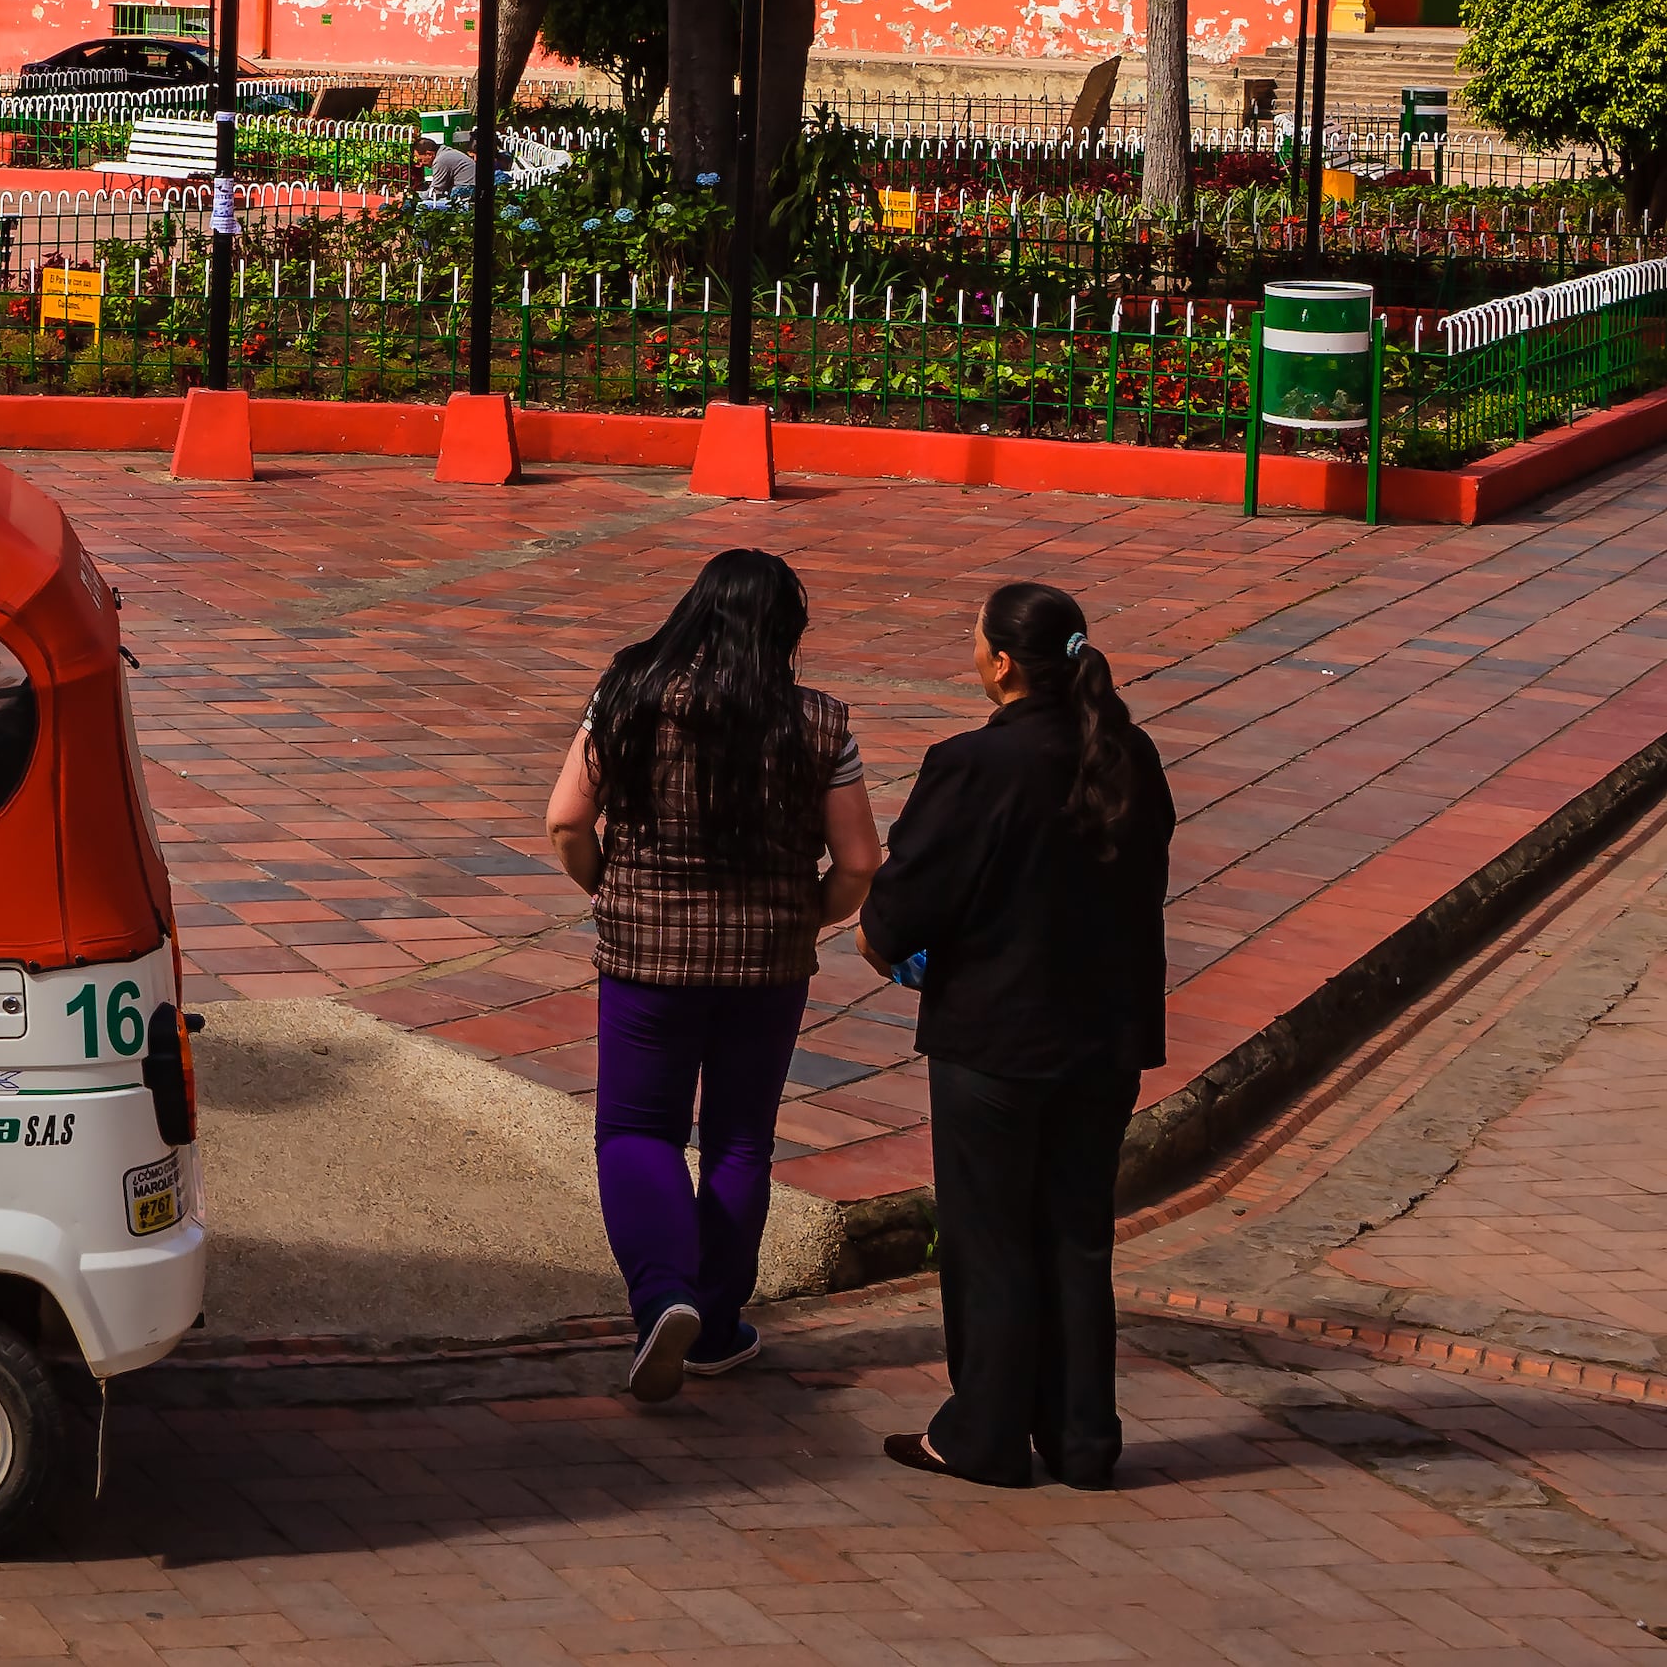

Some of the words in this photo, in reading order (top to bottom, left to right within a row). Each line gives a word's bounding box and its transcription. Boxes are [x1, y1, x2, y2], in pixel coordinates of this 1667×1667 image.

[66, 980, 145, 1059] 16
[24, 1114, 76, 1147] S.A.S
[139, 1193, 172, 1219] #767
